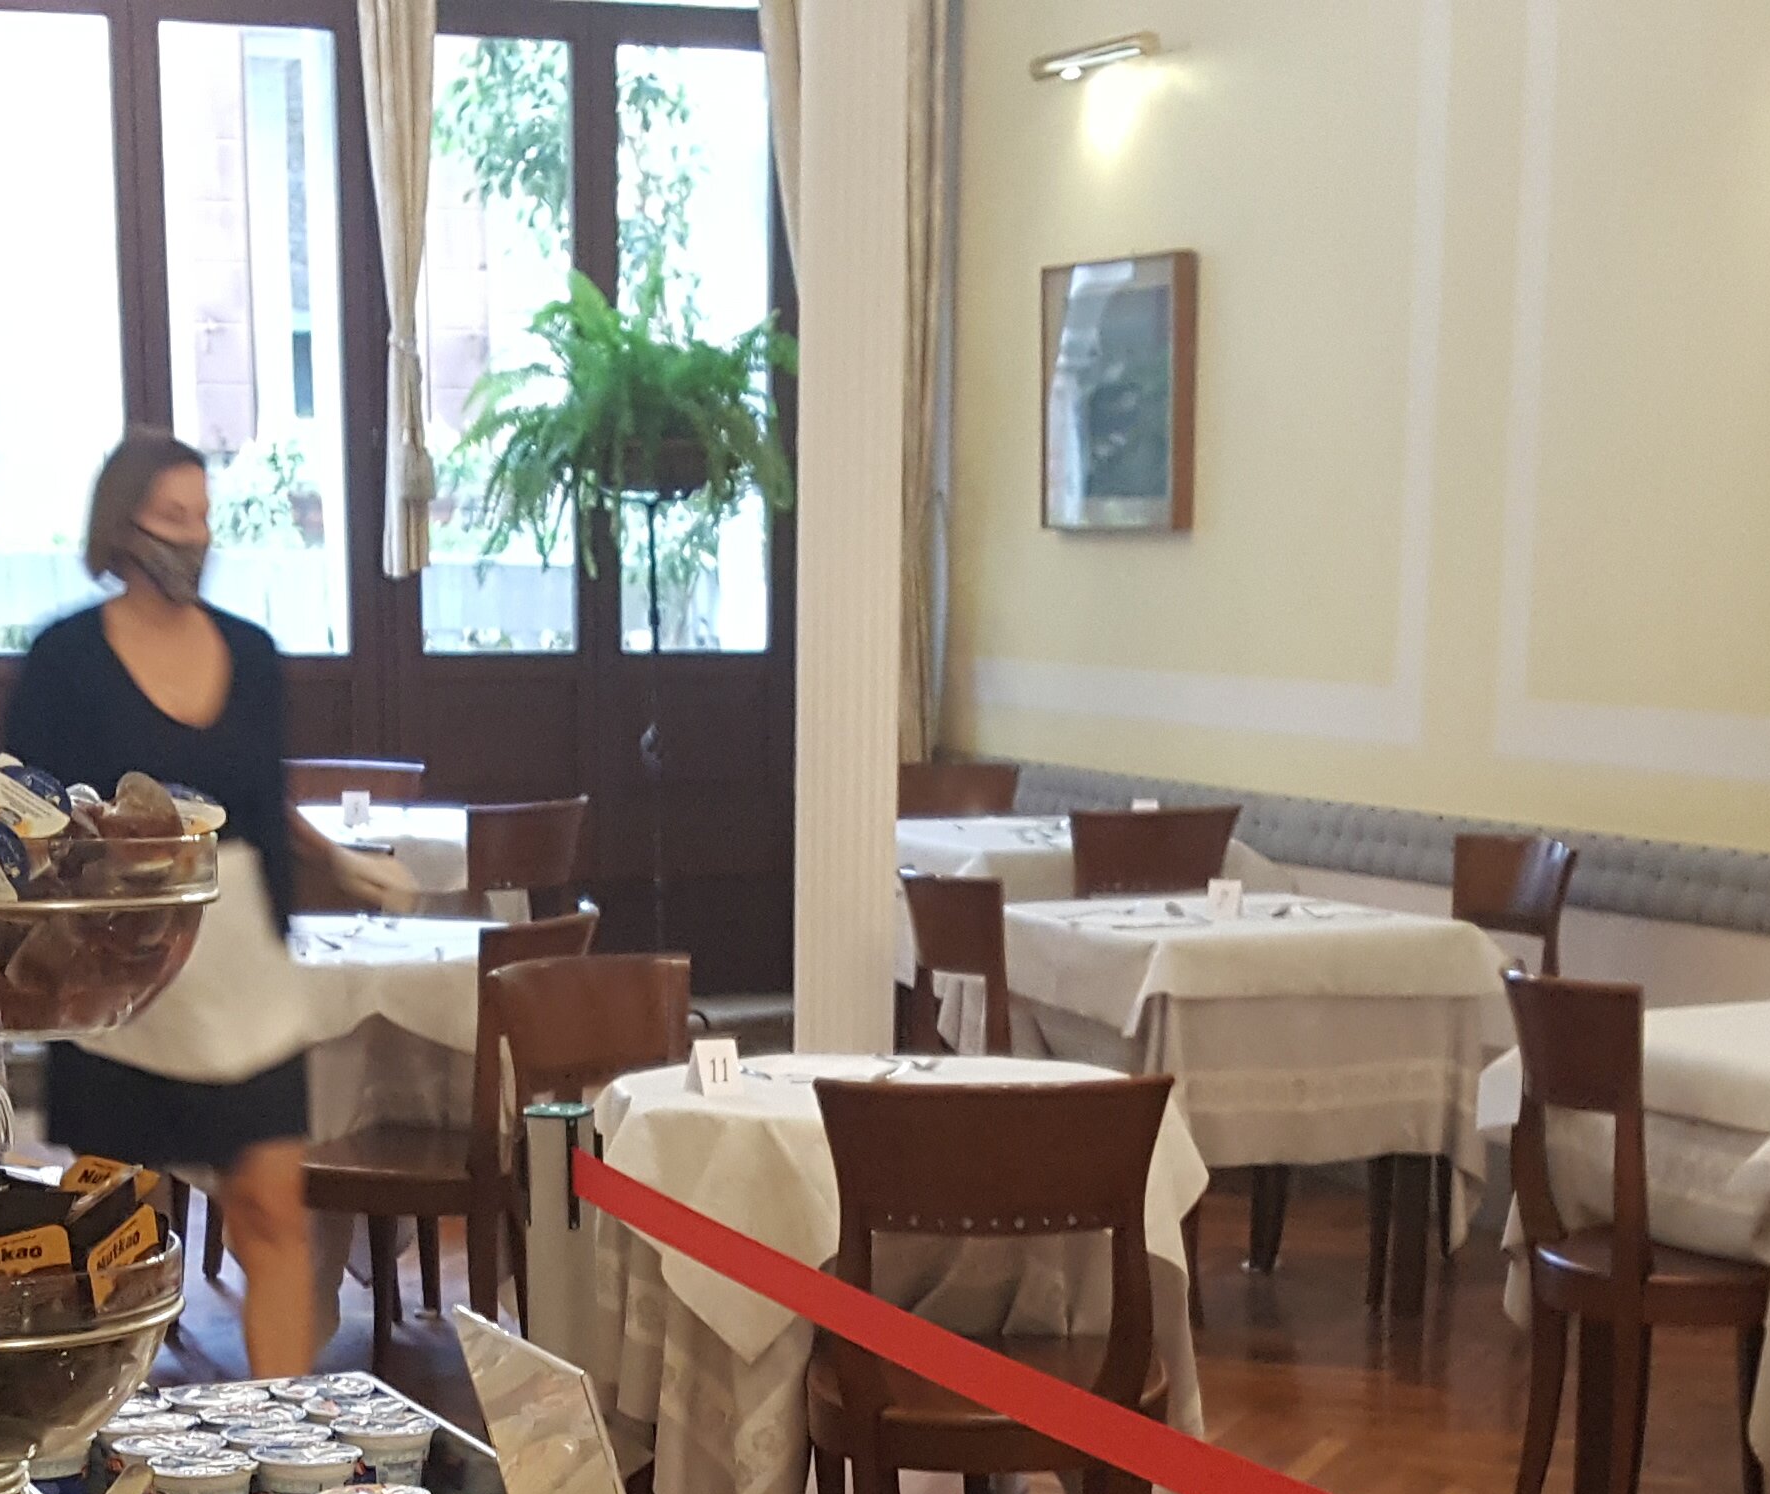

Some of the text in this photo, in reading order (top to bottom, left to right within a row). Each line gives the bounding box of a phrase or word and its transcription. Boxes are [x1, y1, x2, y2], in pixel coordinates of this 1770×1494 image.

[710, 1057, 729, 1083] 11
[77, 1168, 112, 1185] Nut
[96, 1230, 140, 1272] Nutkao
